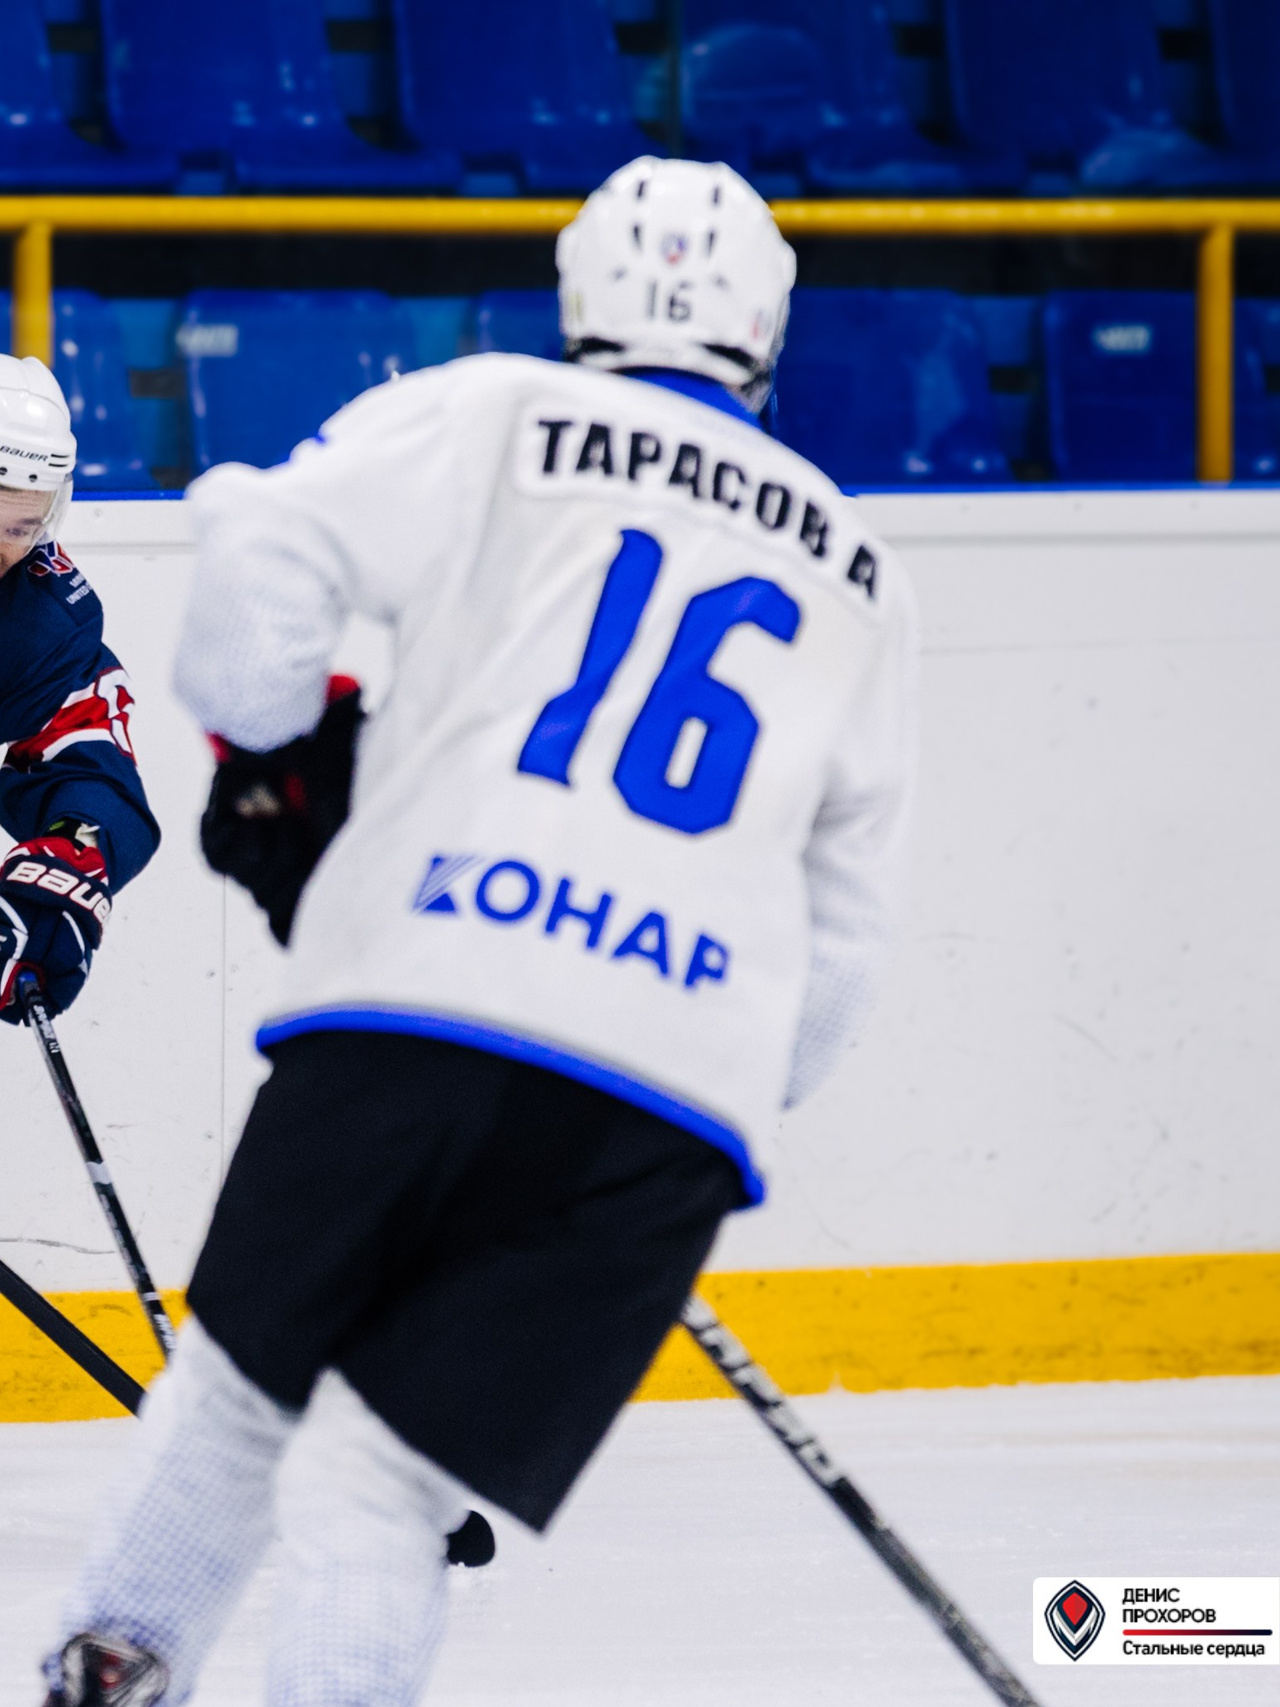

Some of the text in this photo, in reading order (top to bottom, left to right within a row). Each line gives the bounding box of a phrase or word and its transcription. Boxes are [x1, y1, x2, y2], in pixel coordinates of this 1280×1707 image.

[646, 279, 691, 322] 16
[537, 419, 877, 600] ТАРАСОВ А
[517, 528, 802, 836] 16
[6, 861, 112, 924] BAUE
